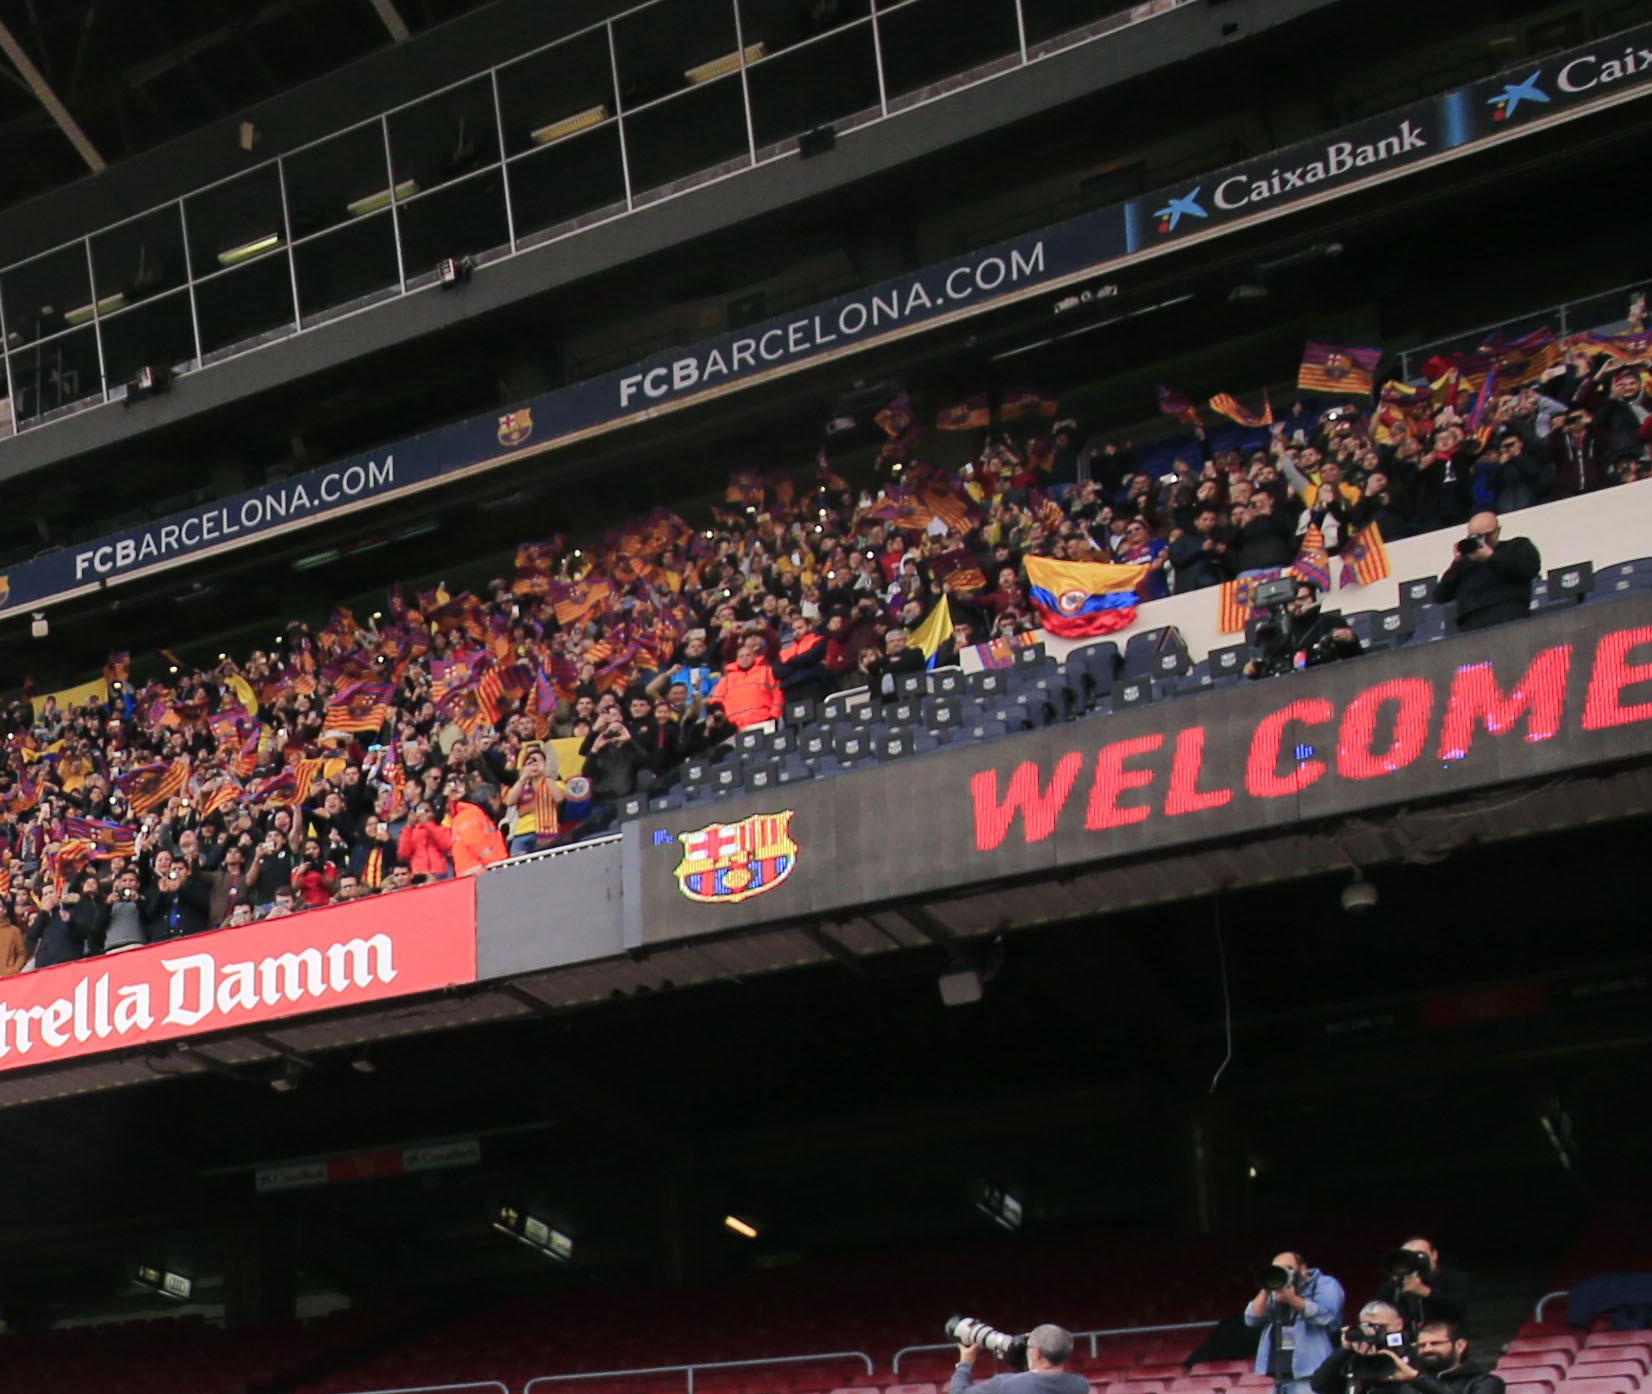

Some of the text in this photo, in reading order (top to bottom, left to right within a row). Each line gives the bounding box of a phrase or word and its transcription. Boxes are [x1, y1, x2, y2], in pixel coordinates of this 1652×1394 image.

[1213, 119, 1428, 212] CaixaBank
[619, 241, 1047, 407] FCBARCELONA.COM
[74, 455, 396, 579] FCBARCELONA.COM
[969, 625, 1652, 853] WELCOME
[161, 933, 396, 1026] Damm
